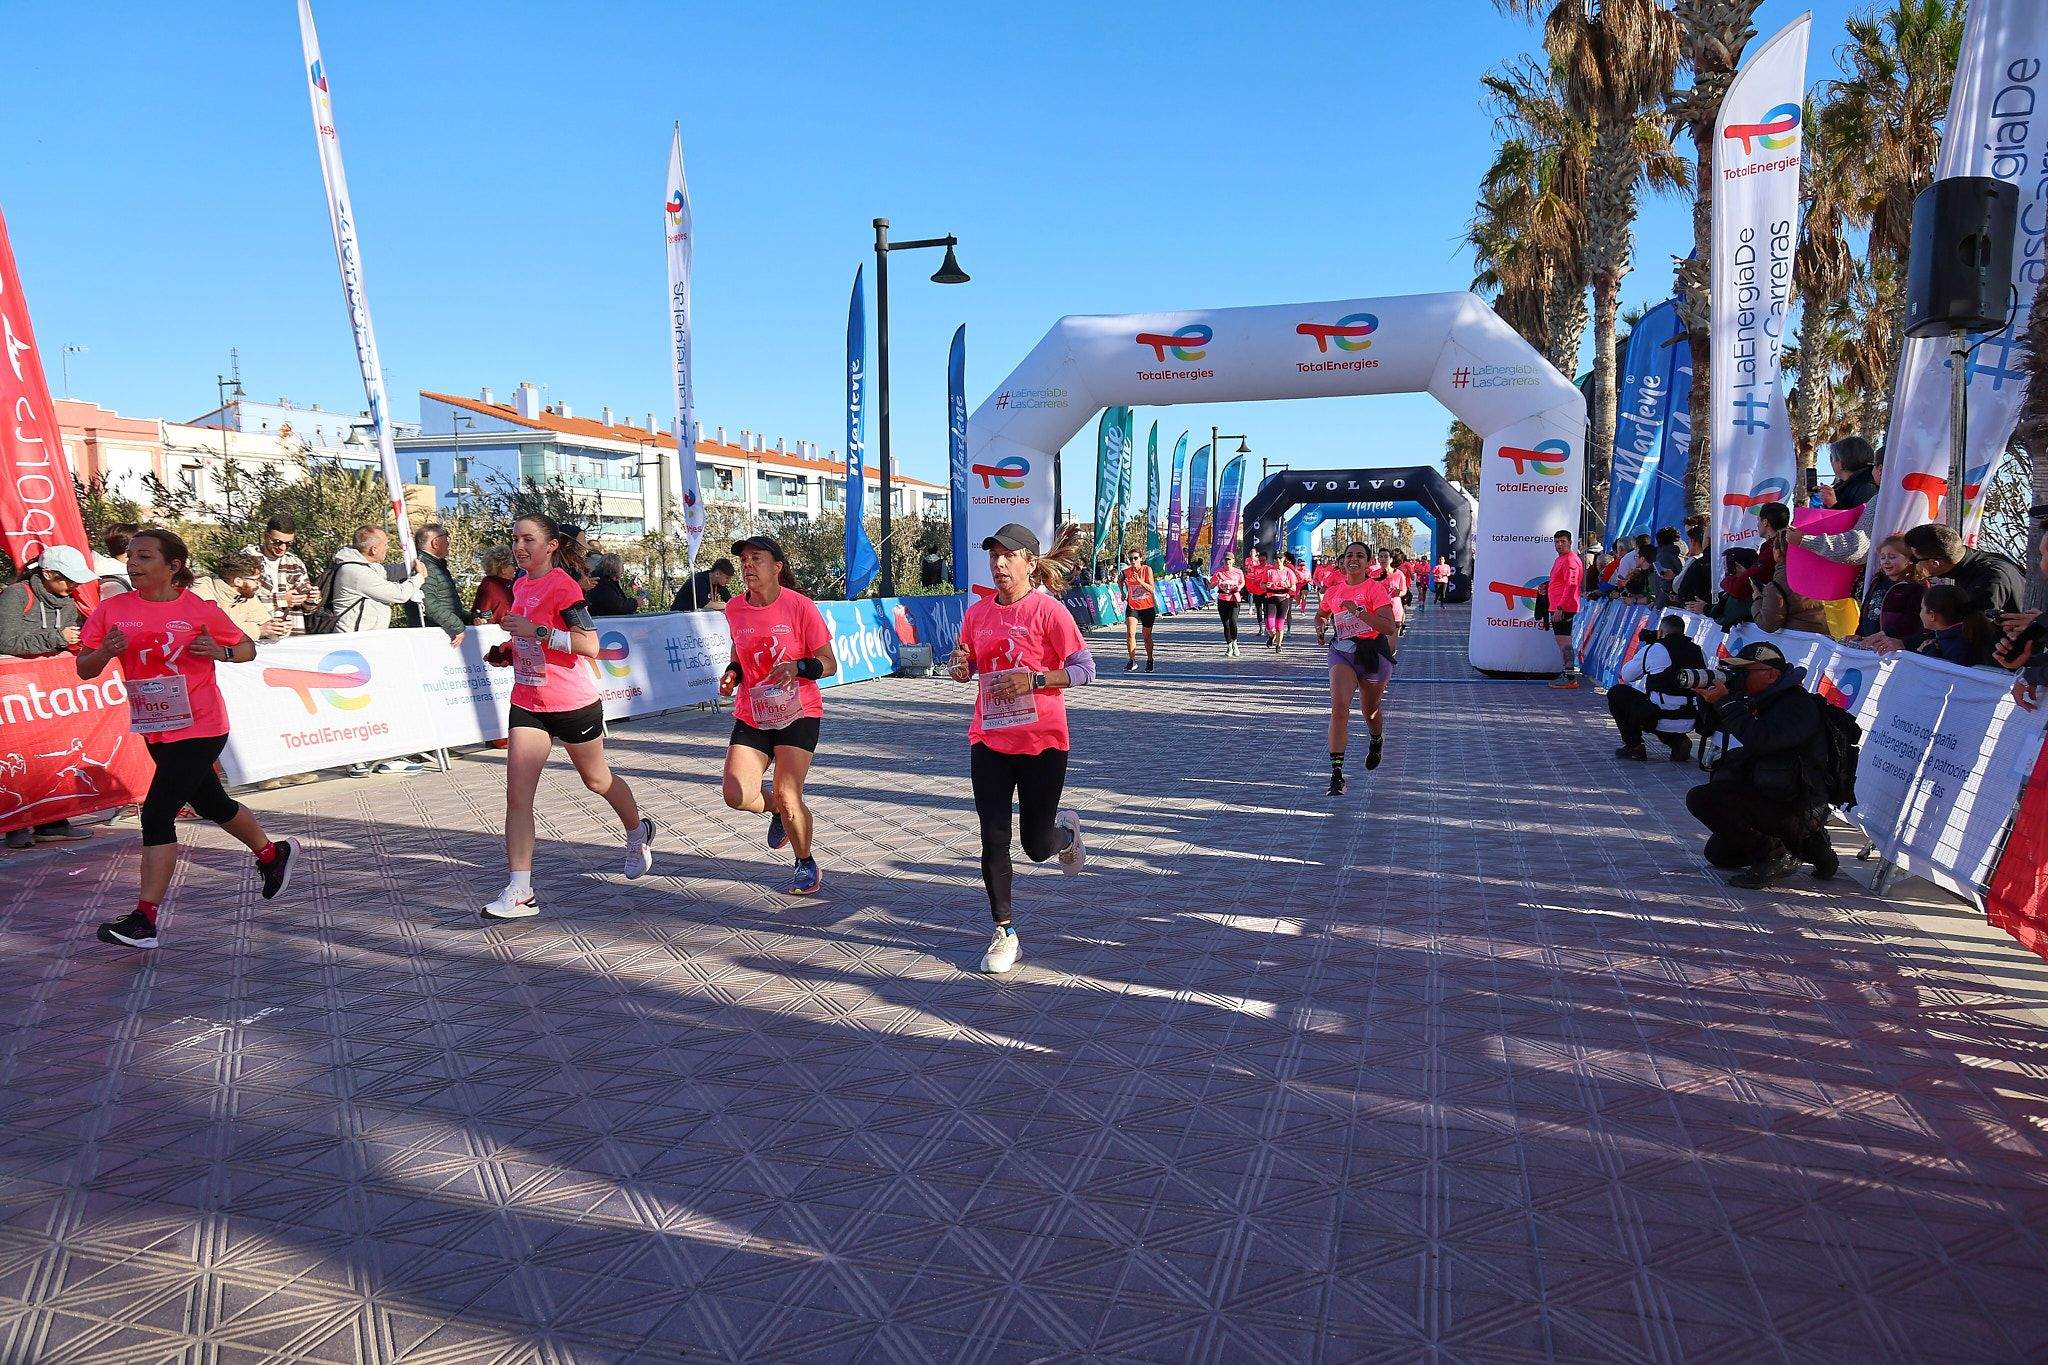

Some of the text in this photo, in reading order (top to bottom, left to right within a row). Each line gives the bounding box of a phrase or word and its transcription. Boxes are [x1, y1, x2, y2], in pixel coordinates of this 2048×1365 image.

[1296, 359, 1379, 373] TotalEnergies
[1136, 368, 1214, 381] TotalEnergies
[1473, 376, 1540, 388] LasCarreras
[1614, 375, 1667, 485] Marlene
[1303, 478, 1406, 491] VOLVO
[1495, 482, 1569, 495] TotalEnergies
[971, 495, 1030, 506] TotalEnergies
[0, 670, 128, 726] ntand
[145, 701, 170, 712] 016
[768, 703, 787, 714] 016
[1891, 714, 1914, 734] Somos
[280, 721, 390, 750] TotalEnergies
[1868, 729, 1918, 760] multienergías
[1881, 761, 1908, 781] carreras
